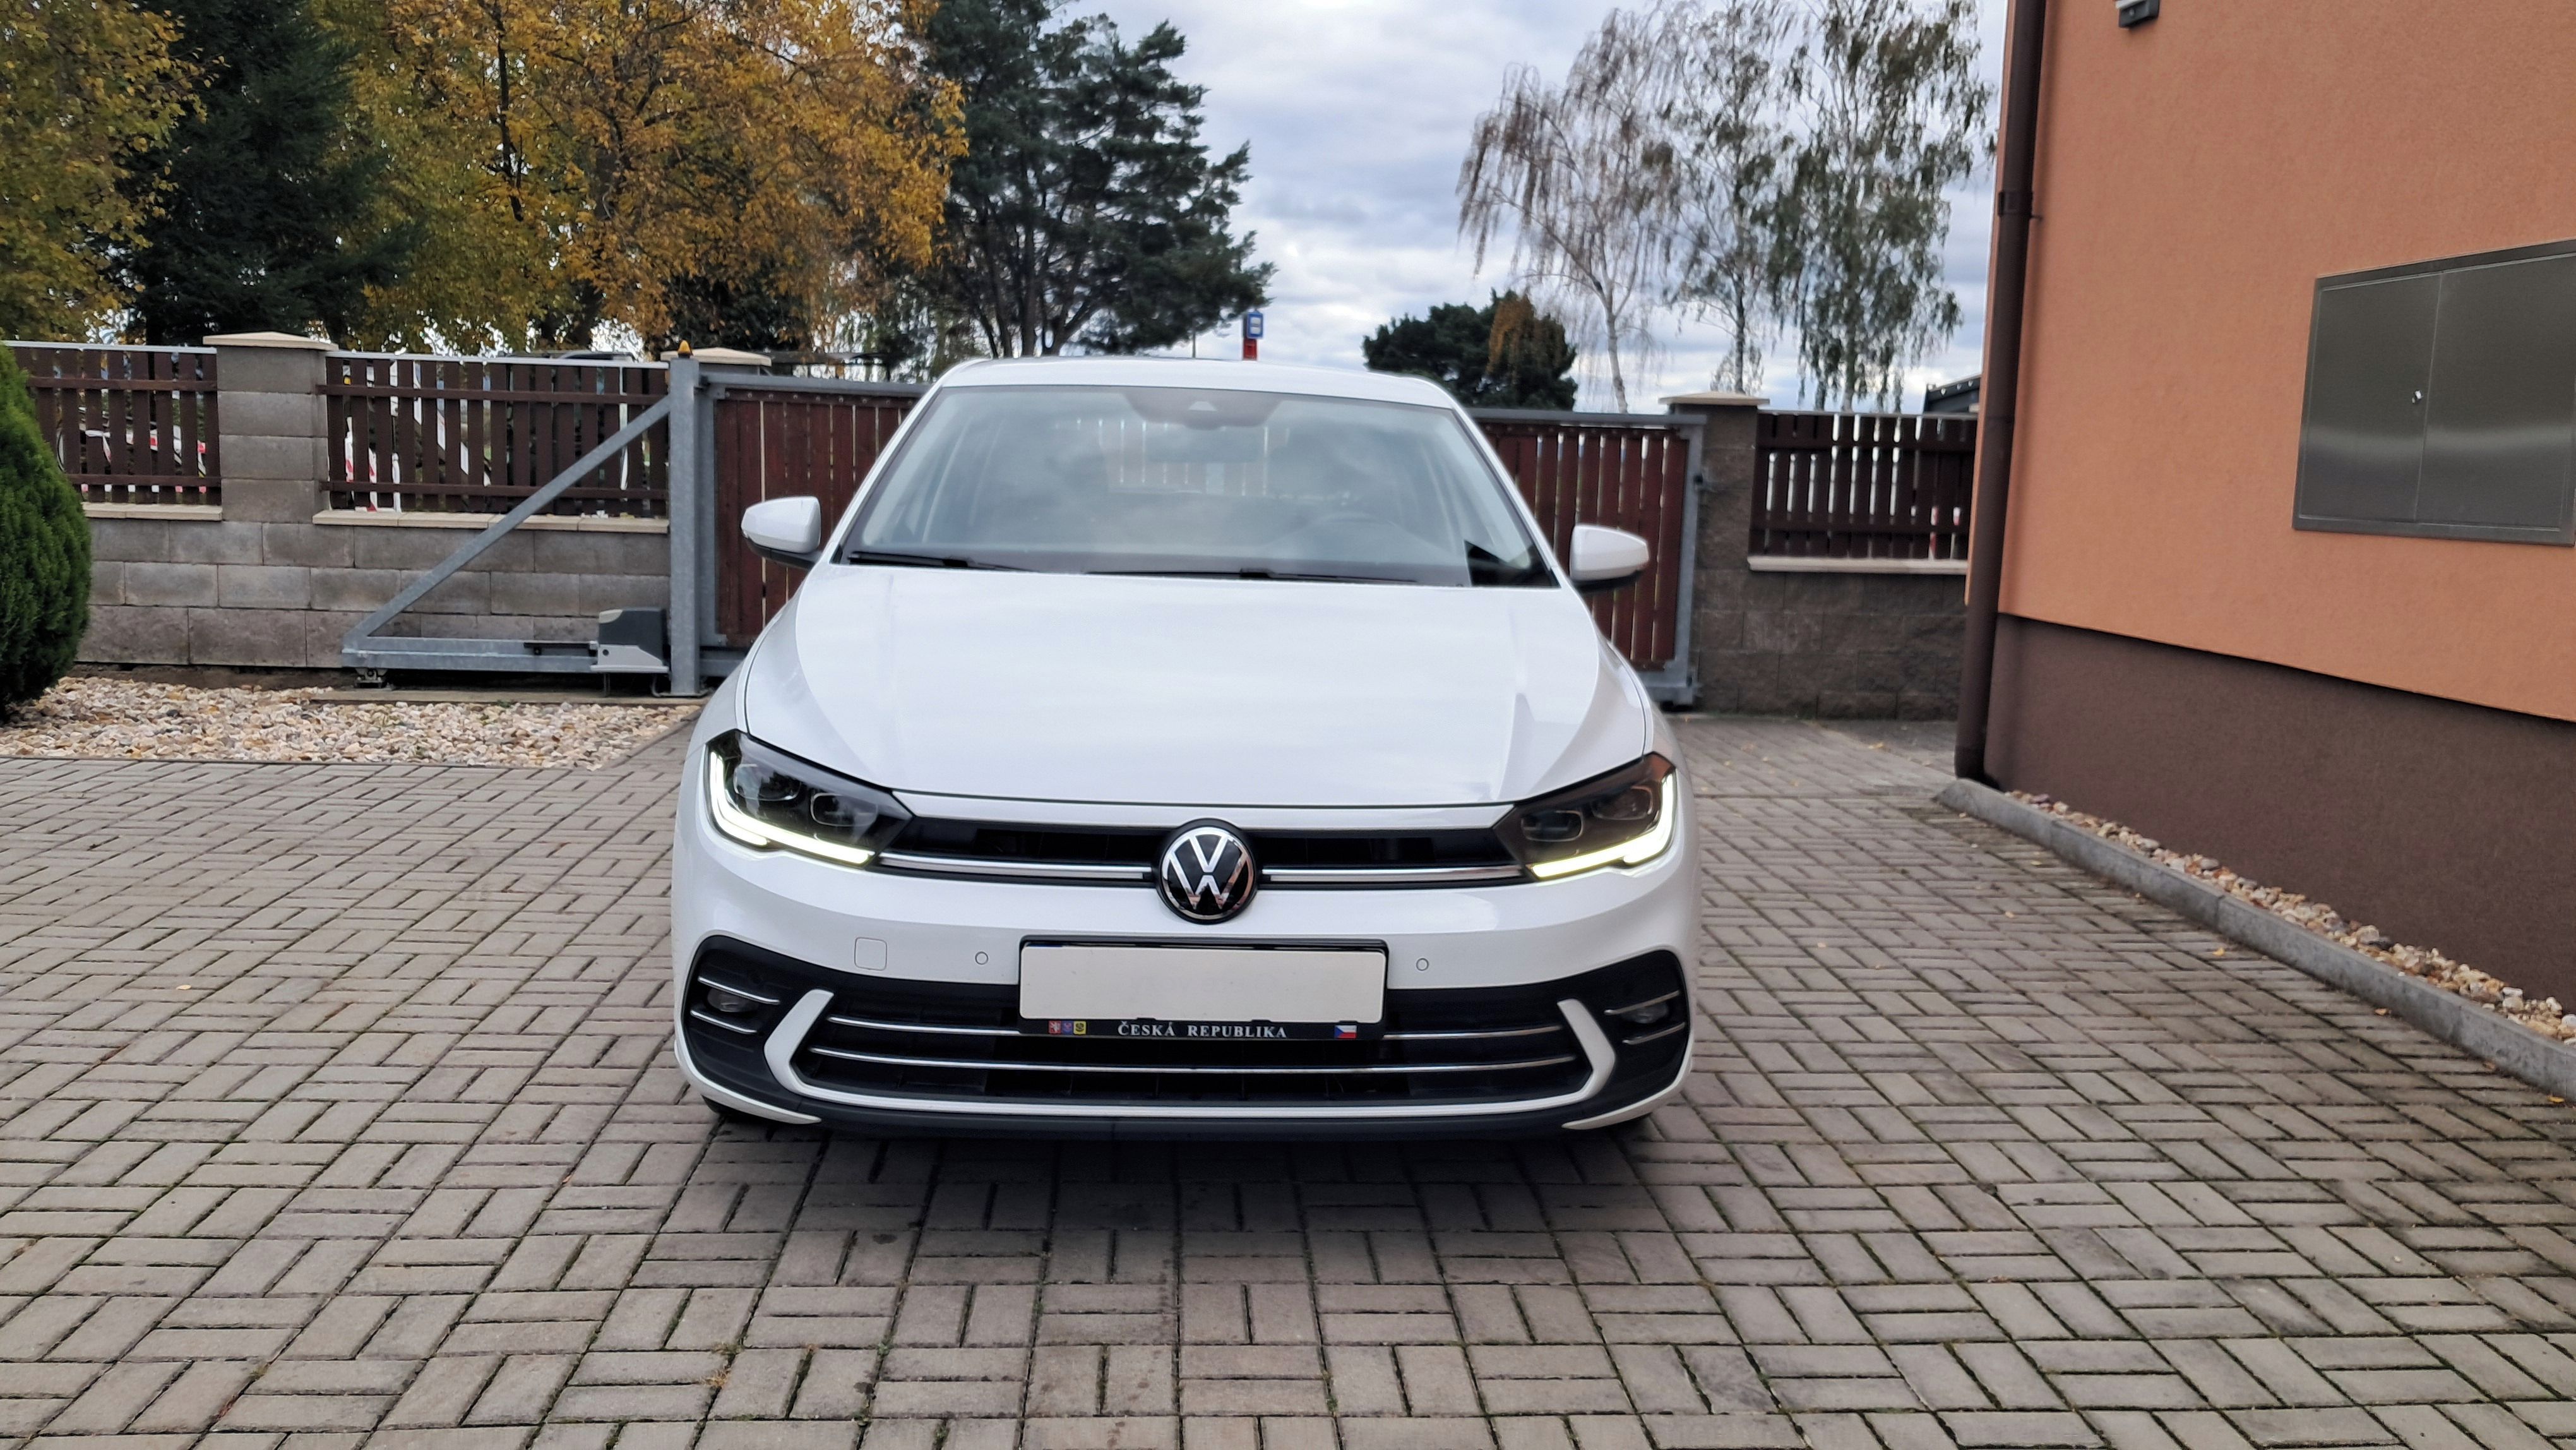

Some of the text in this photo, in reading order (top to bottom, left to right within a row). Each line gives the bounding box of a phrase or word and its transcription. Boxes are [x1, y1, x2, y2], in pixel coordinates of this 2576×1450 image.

[1164, 830, 1251, 911] VW
[1118, 1021, 1287, 1038] ČESKÁ REPUBLIKA
